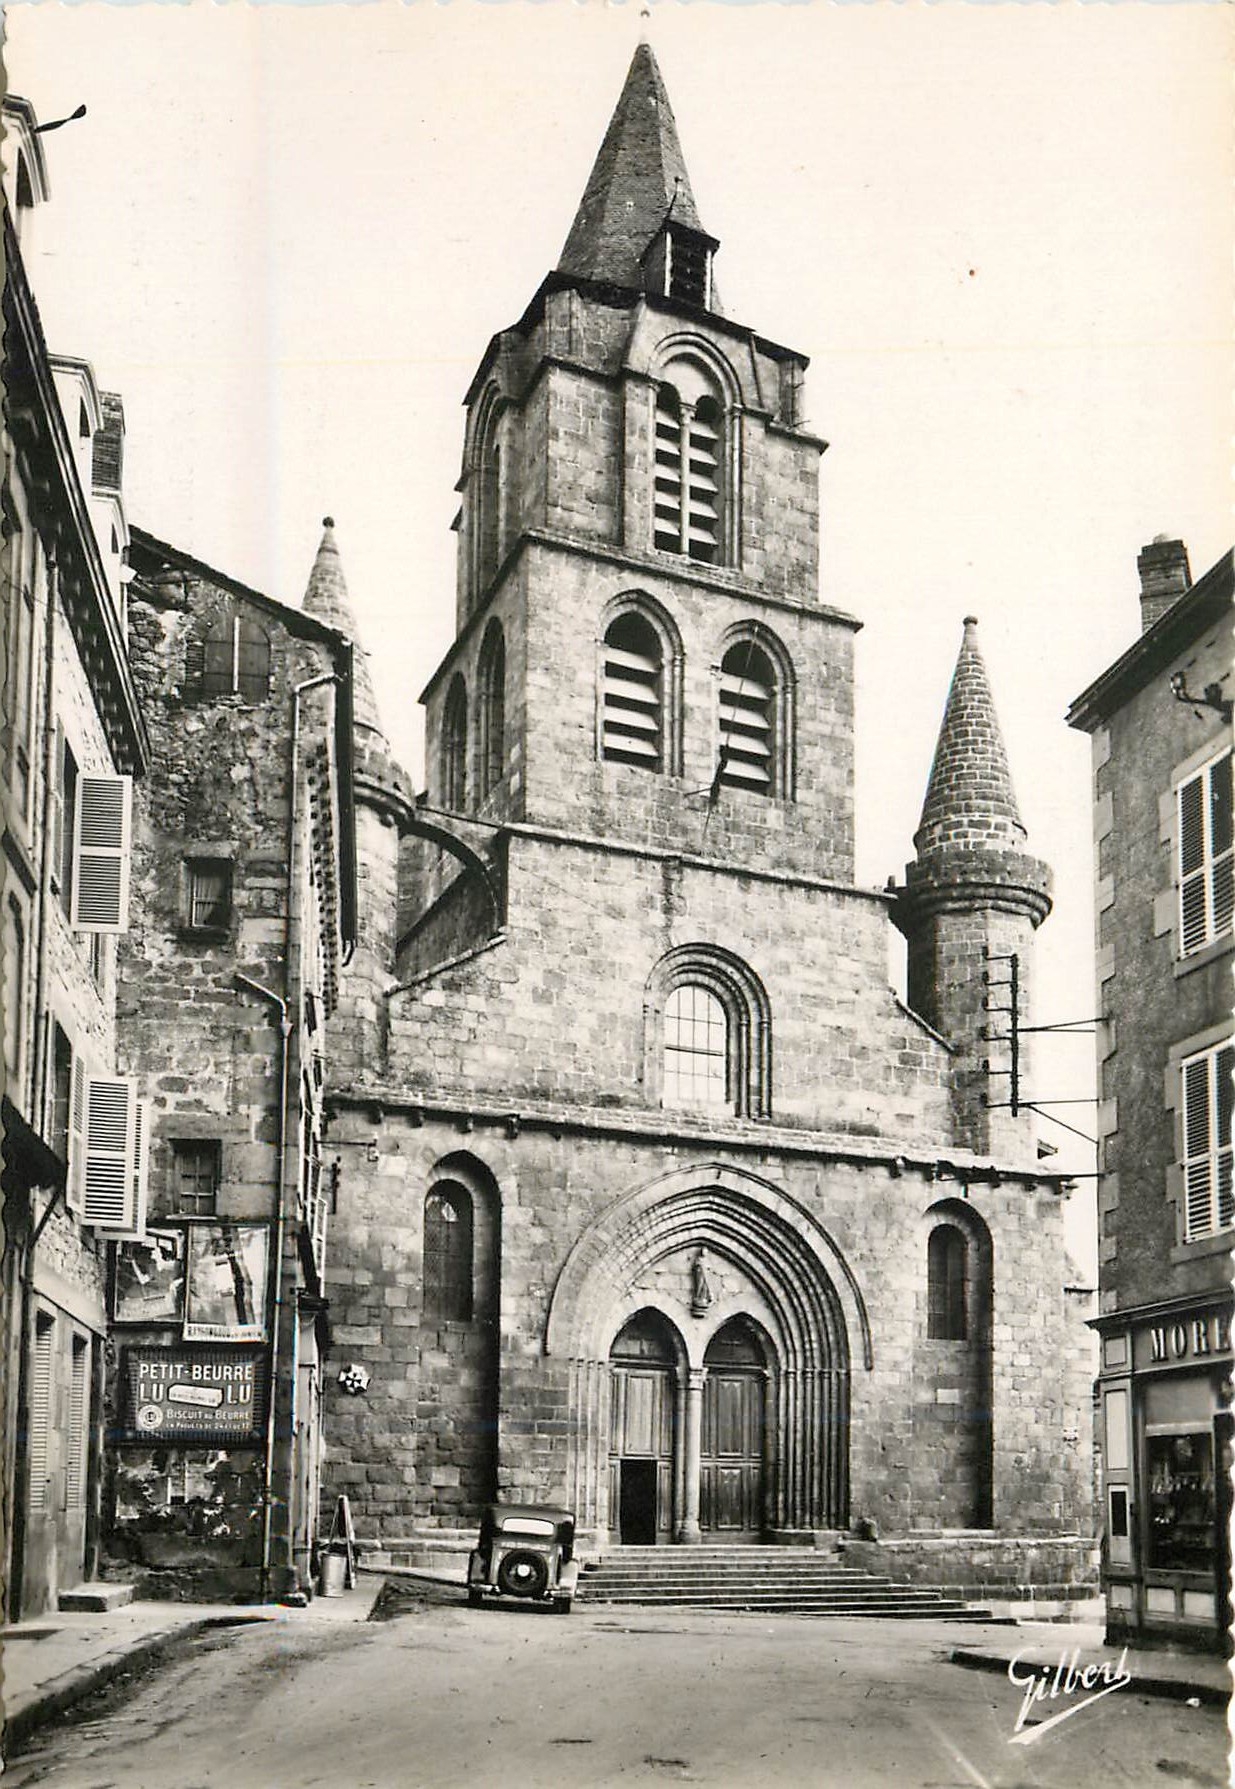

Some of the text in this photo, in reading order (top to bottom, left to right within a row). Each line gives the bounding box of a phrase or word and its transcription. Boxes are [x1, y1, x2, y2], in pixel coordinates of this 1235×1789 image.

[139, 1363, 253, 1381] PETIT-BEURRE
[139, 1383, 165, 1403] LU
[226, 1384, 251, 1405] LU
